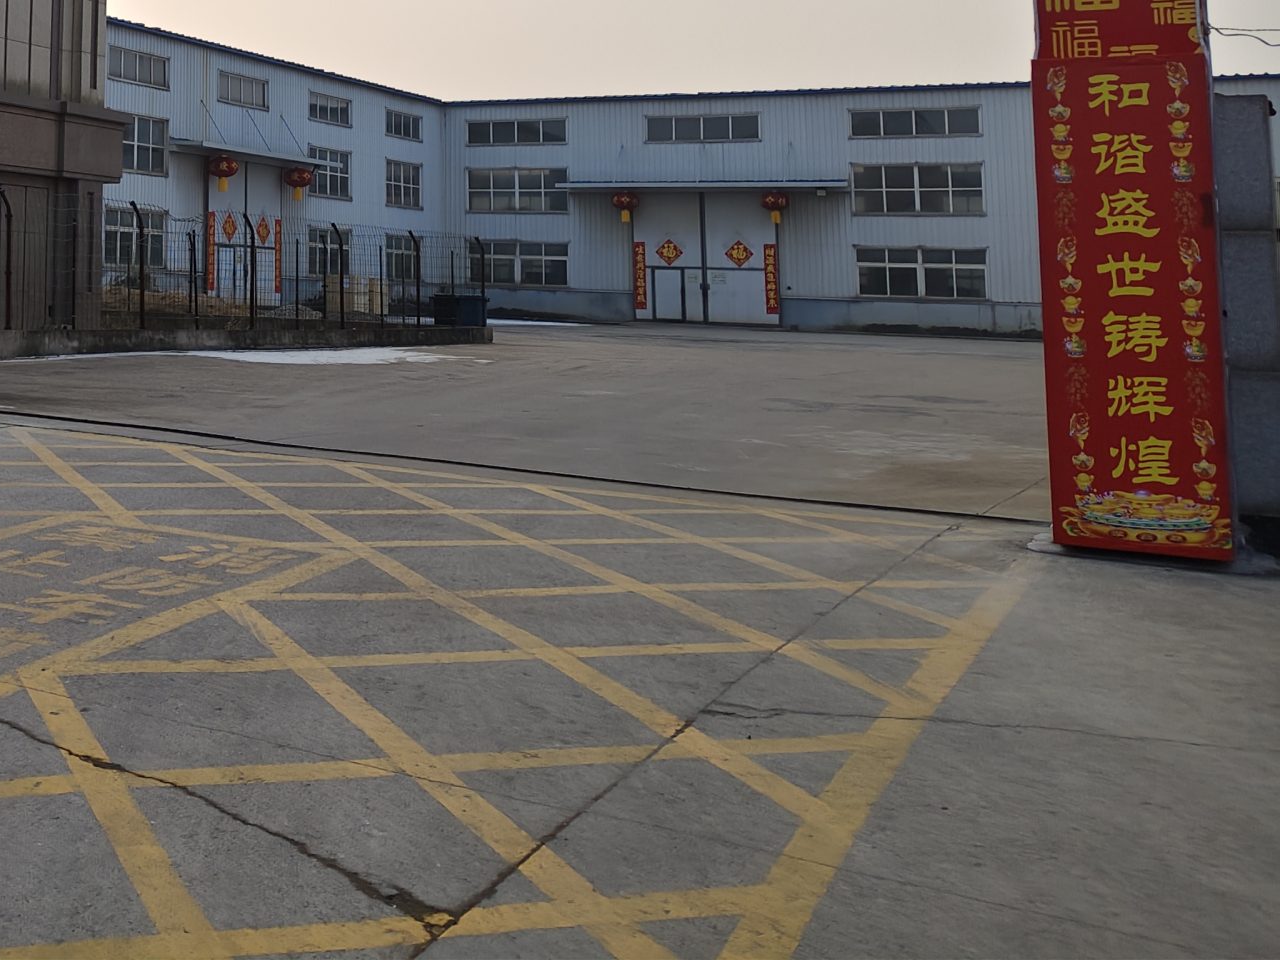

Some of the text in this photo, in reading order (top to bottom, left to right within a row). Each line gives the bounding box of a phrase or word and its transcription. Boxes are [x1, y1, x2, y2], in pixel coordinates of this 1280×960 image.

[1086, 73, 1181, 486] 和谐盛世铸辉煌
